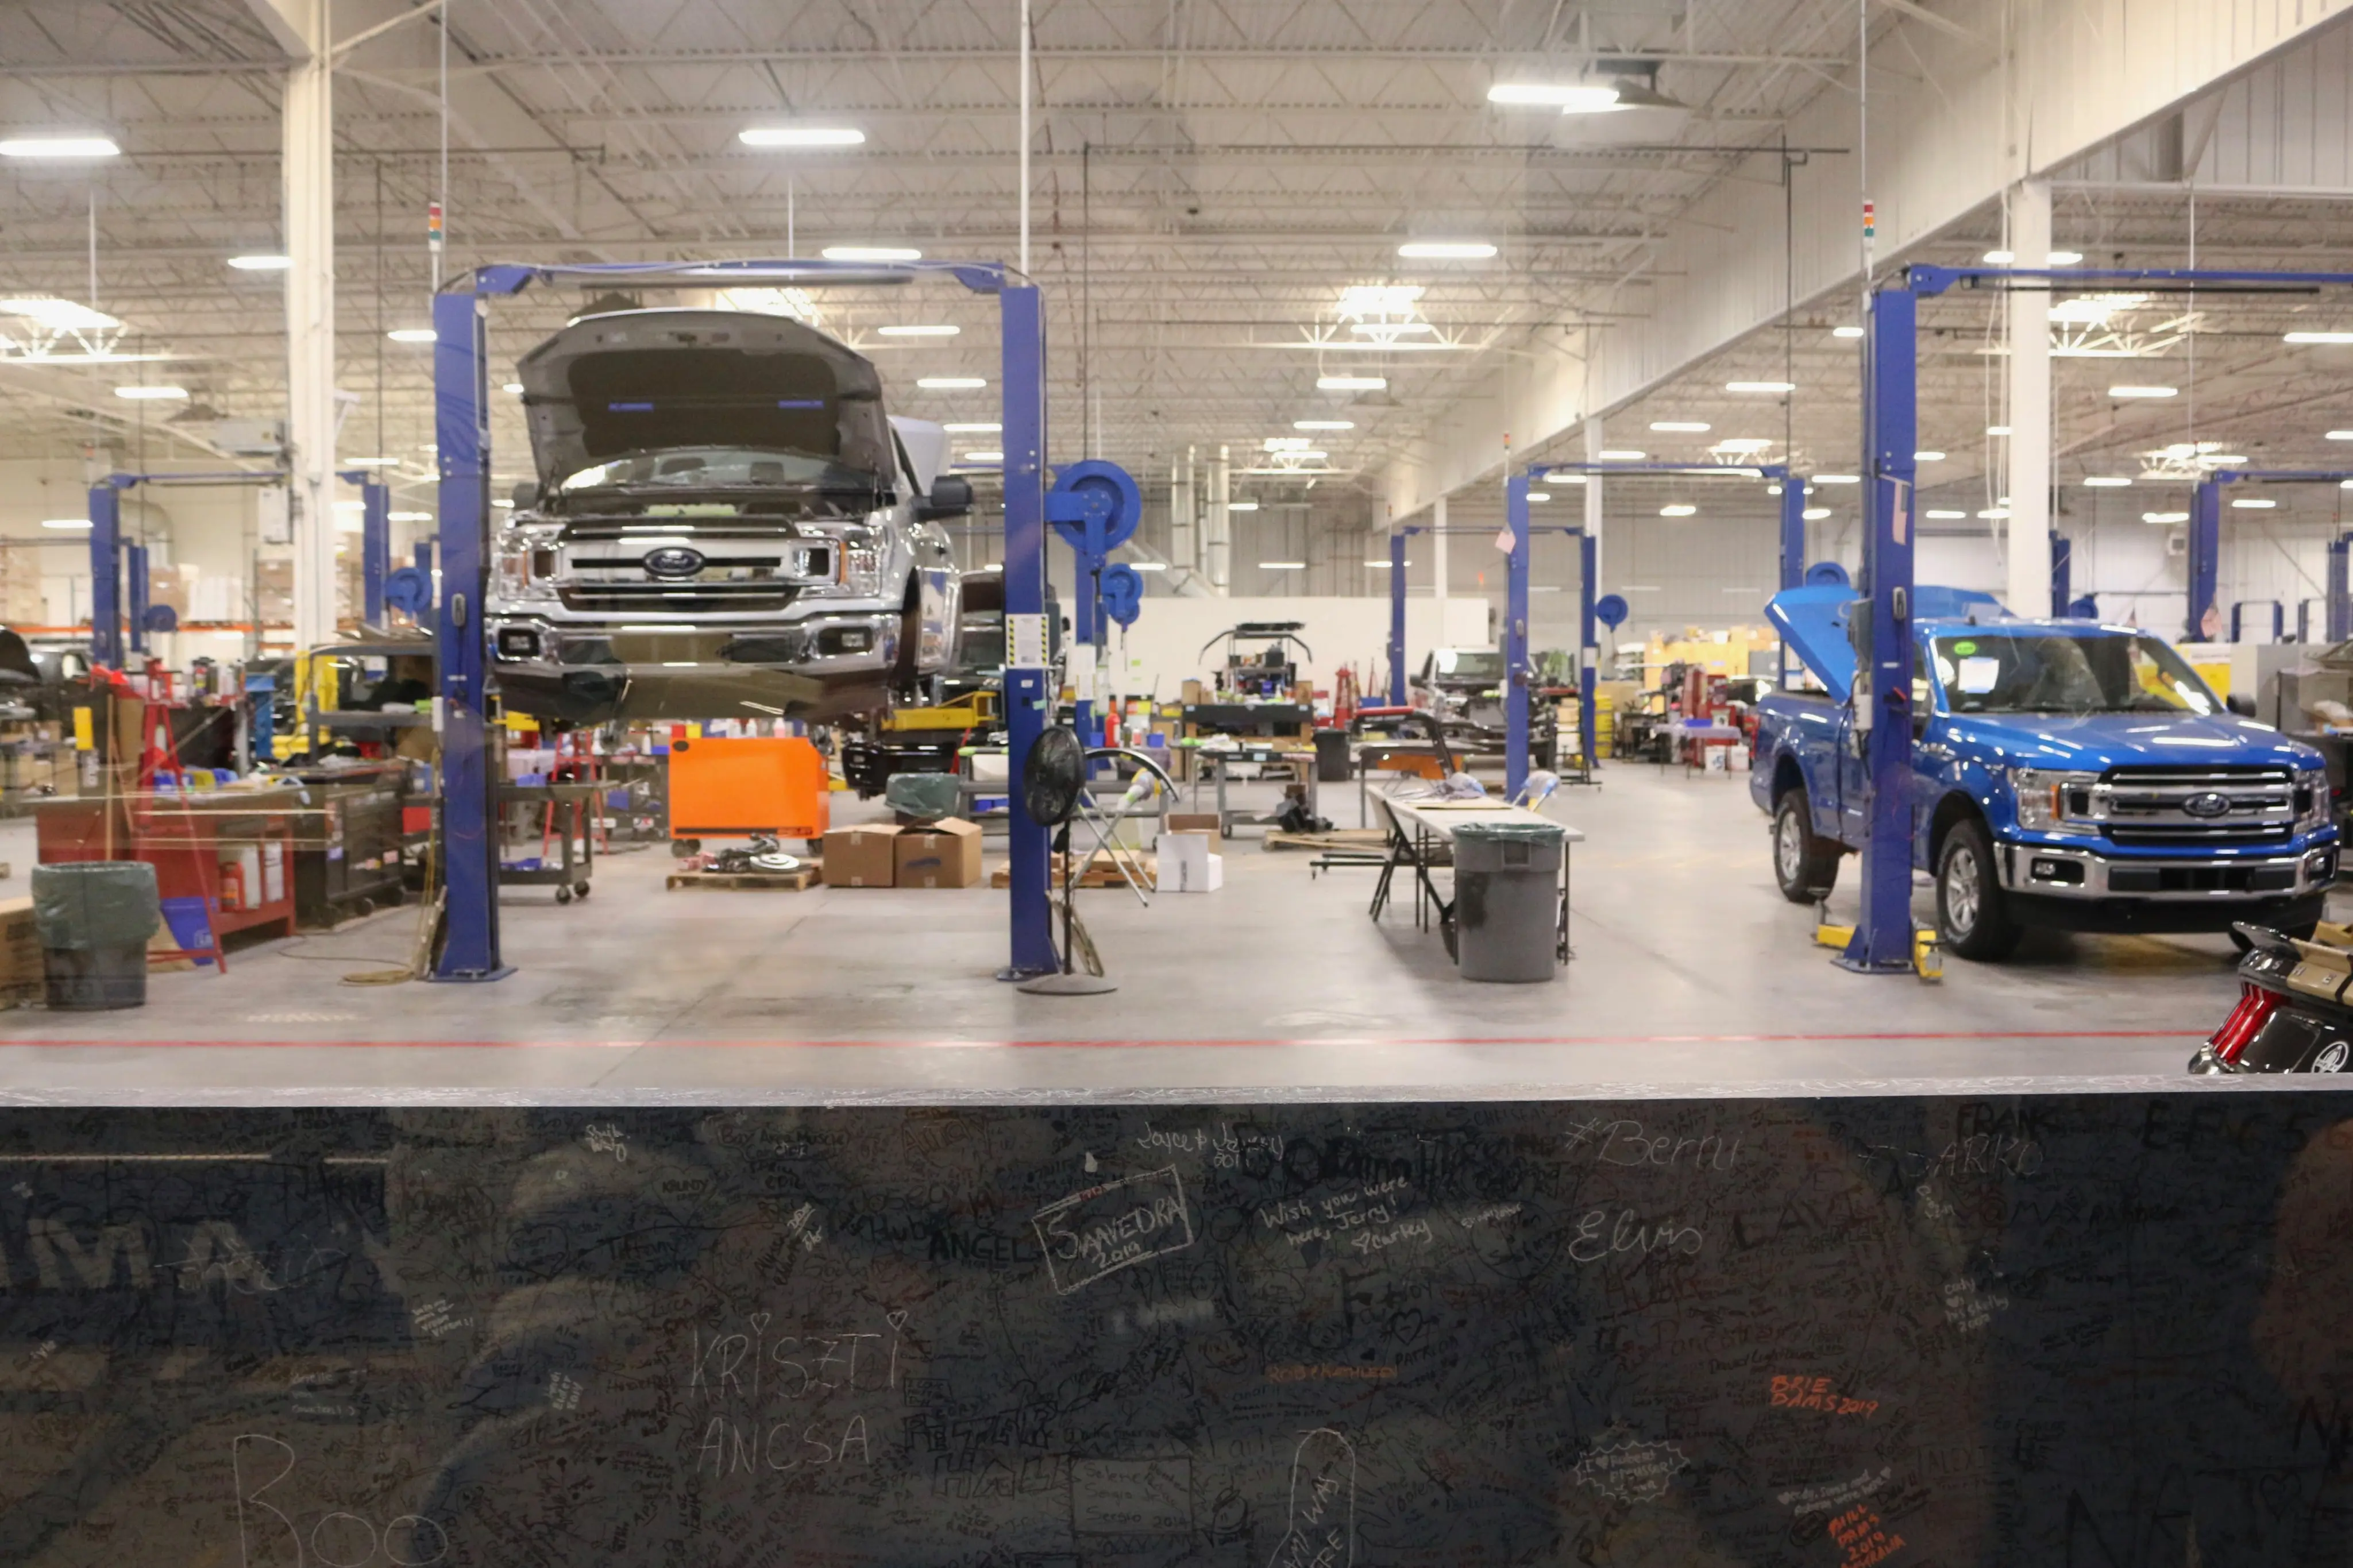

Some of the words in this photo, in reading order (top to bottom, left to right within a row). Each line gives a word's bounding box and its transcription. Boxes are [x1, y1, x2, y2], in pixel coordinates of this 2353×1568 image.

[1259, 1201, 1311, 1228] Wish
[1323, 1192, 1356, 1218] you
[1365, 1176, 1407, 1196] were
[1568, 1208, 1703, 1262] Elvis
[694, 1414, 870, 1478] ANCSA
